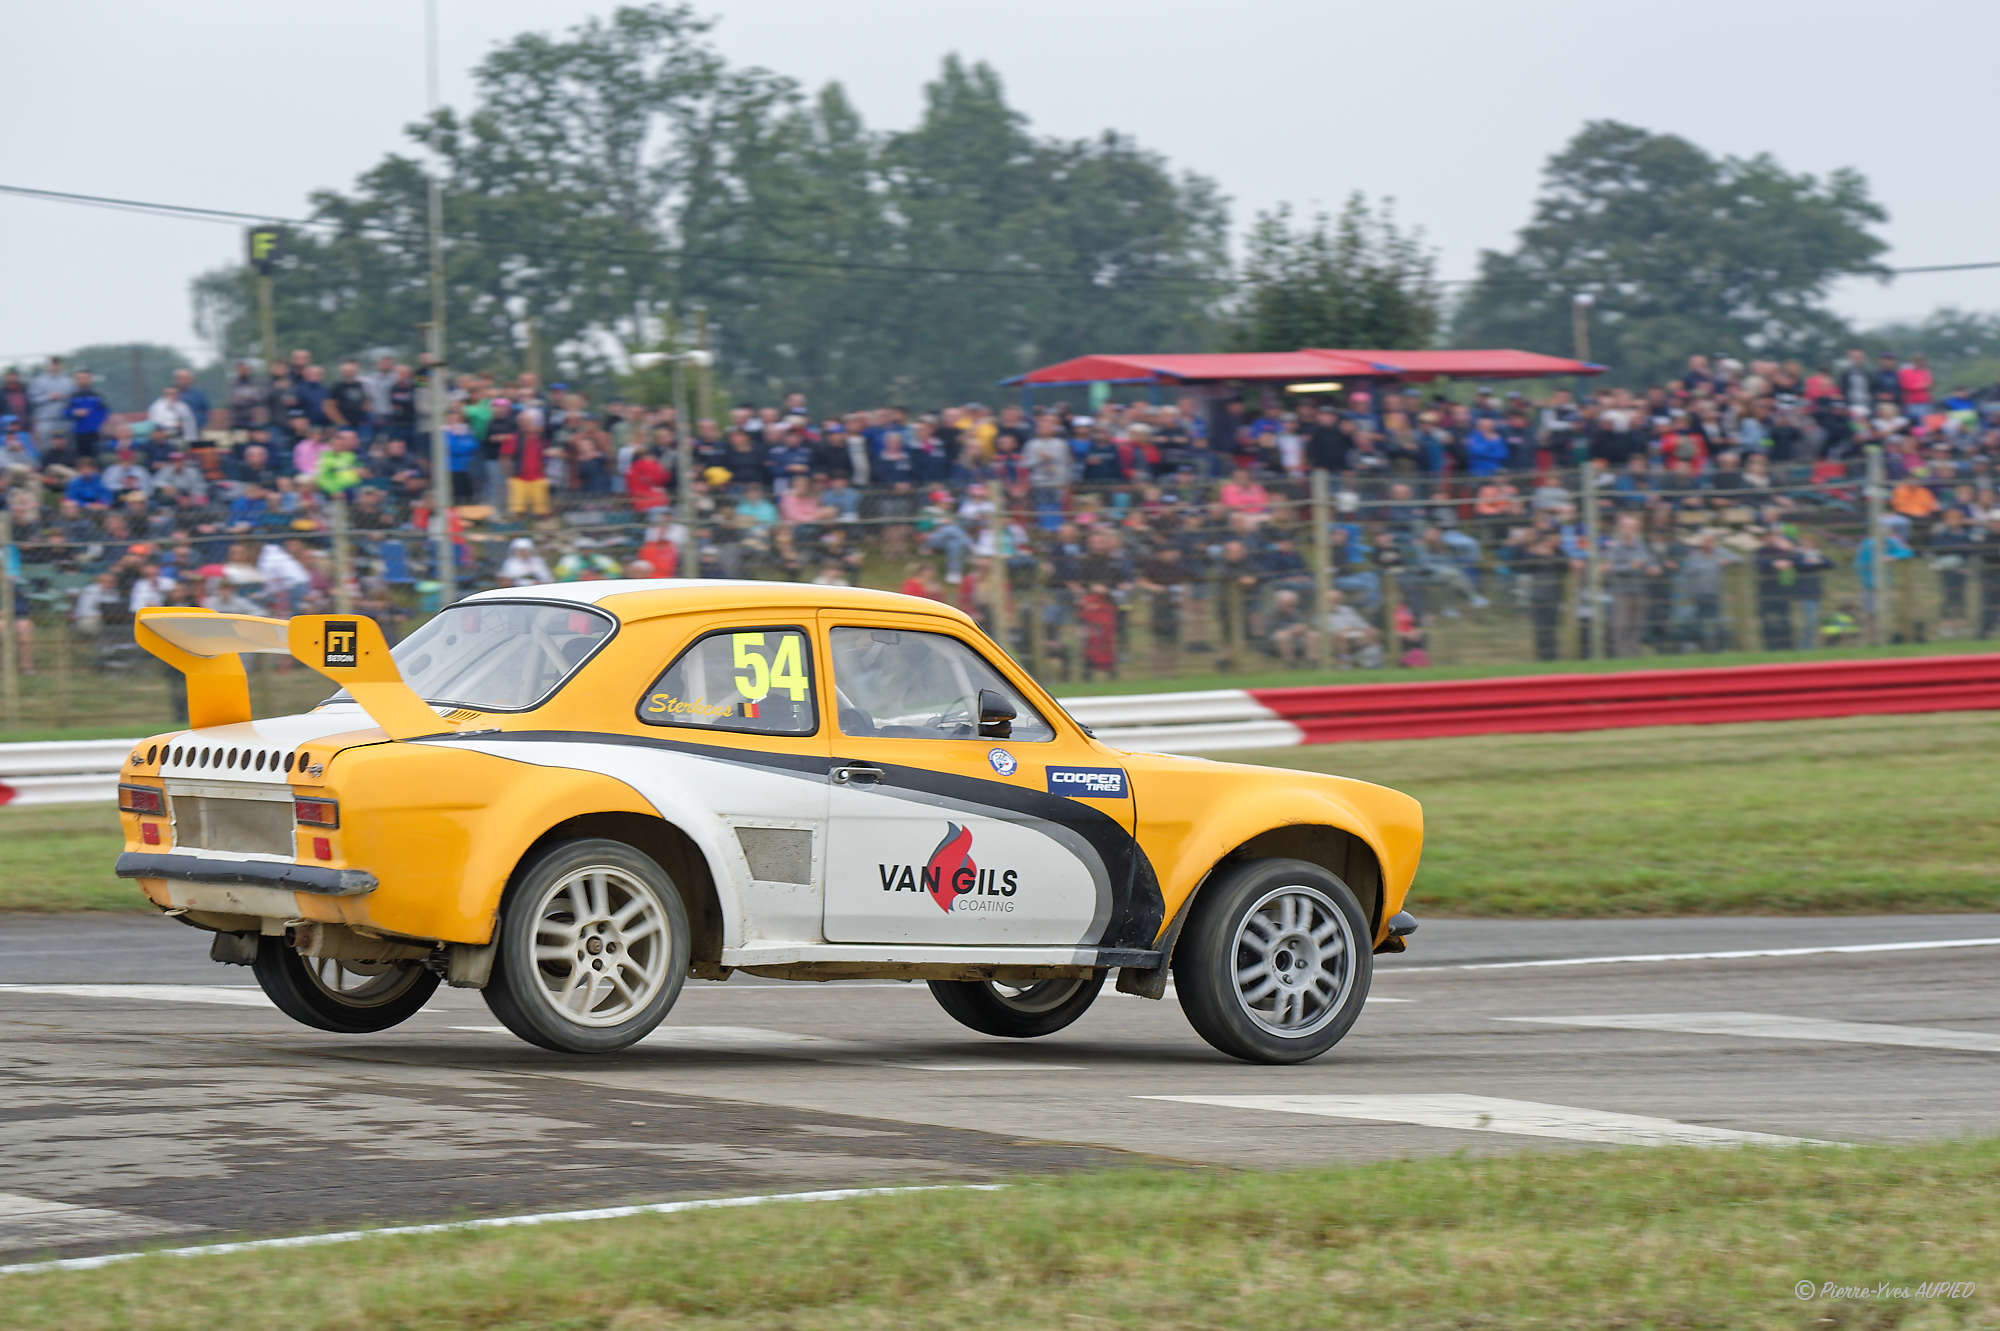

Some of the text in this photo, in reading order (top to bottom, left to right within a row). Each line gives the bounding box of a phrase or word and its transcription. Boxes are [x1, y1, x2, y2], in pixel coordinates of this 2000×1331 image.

[327, 631, 355, 653] FT
[732, 632, 809, 702] 54
[648, 693, 734, 718] Sterkens
[1051, 772, 1121, 785] COOPER
[1085, 783, 1121, 792] TIRES
[878, 863, 1018, 897] VAN GILS
[958, 899, 1015, 913] COATING
